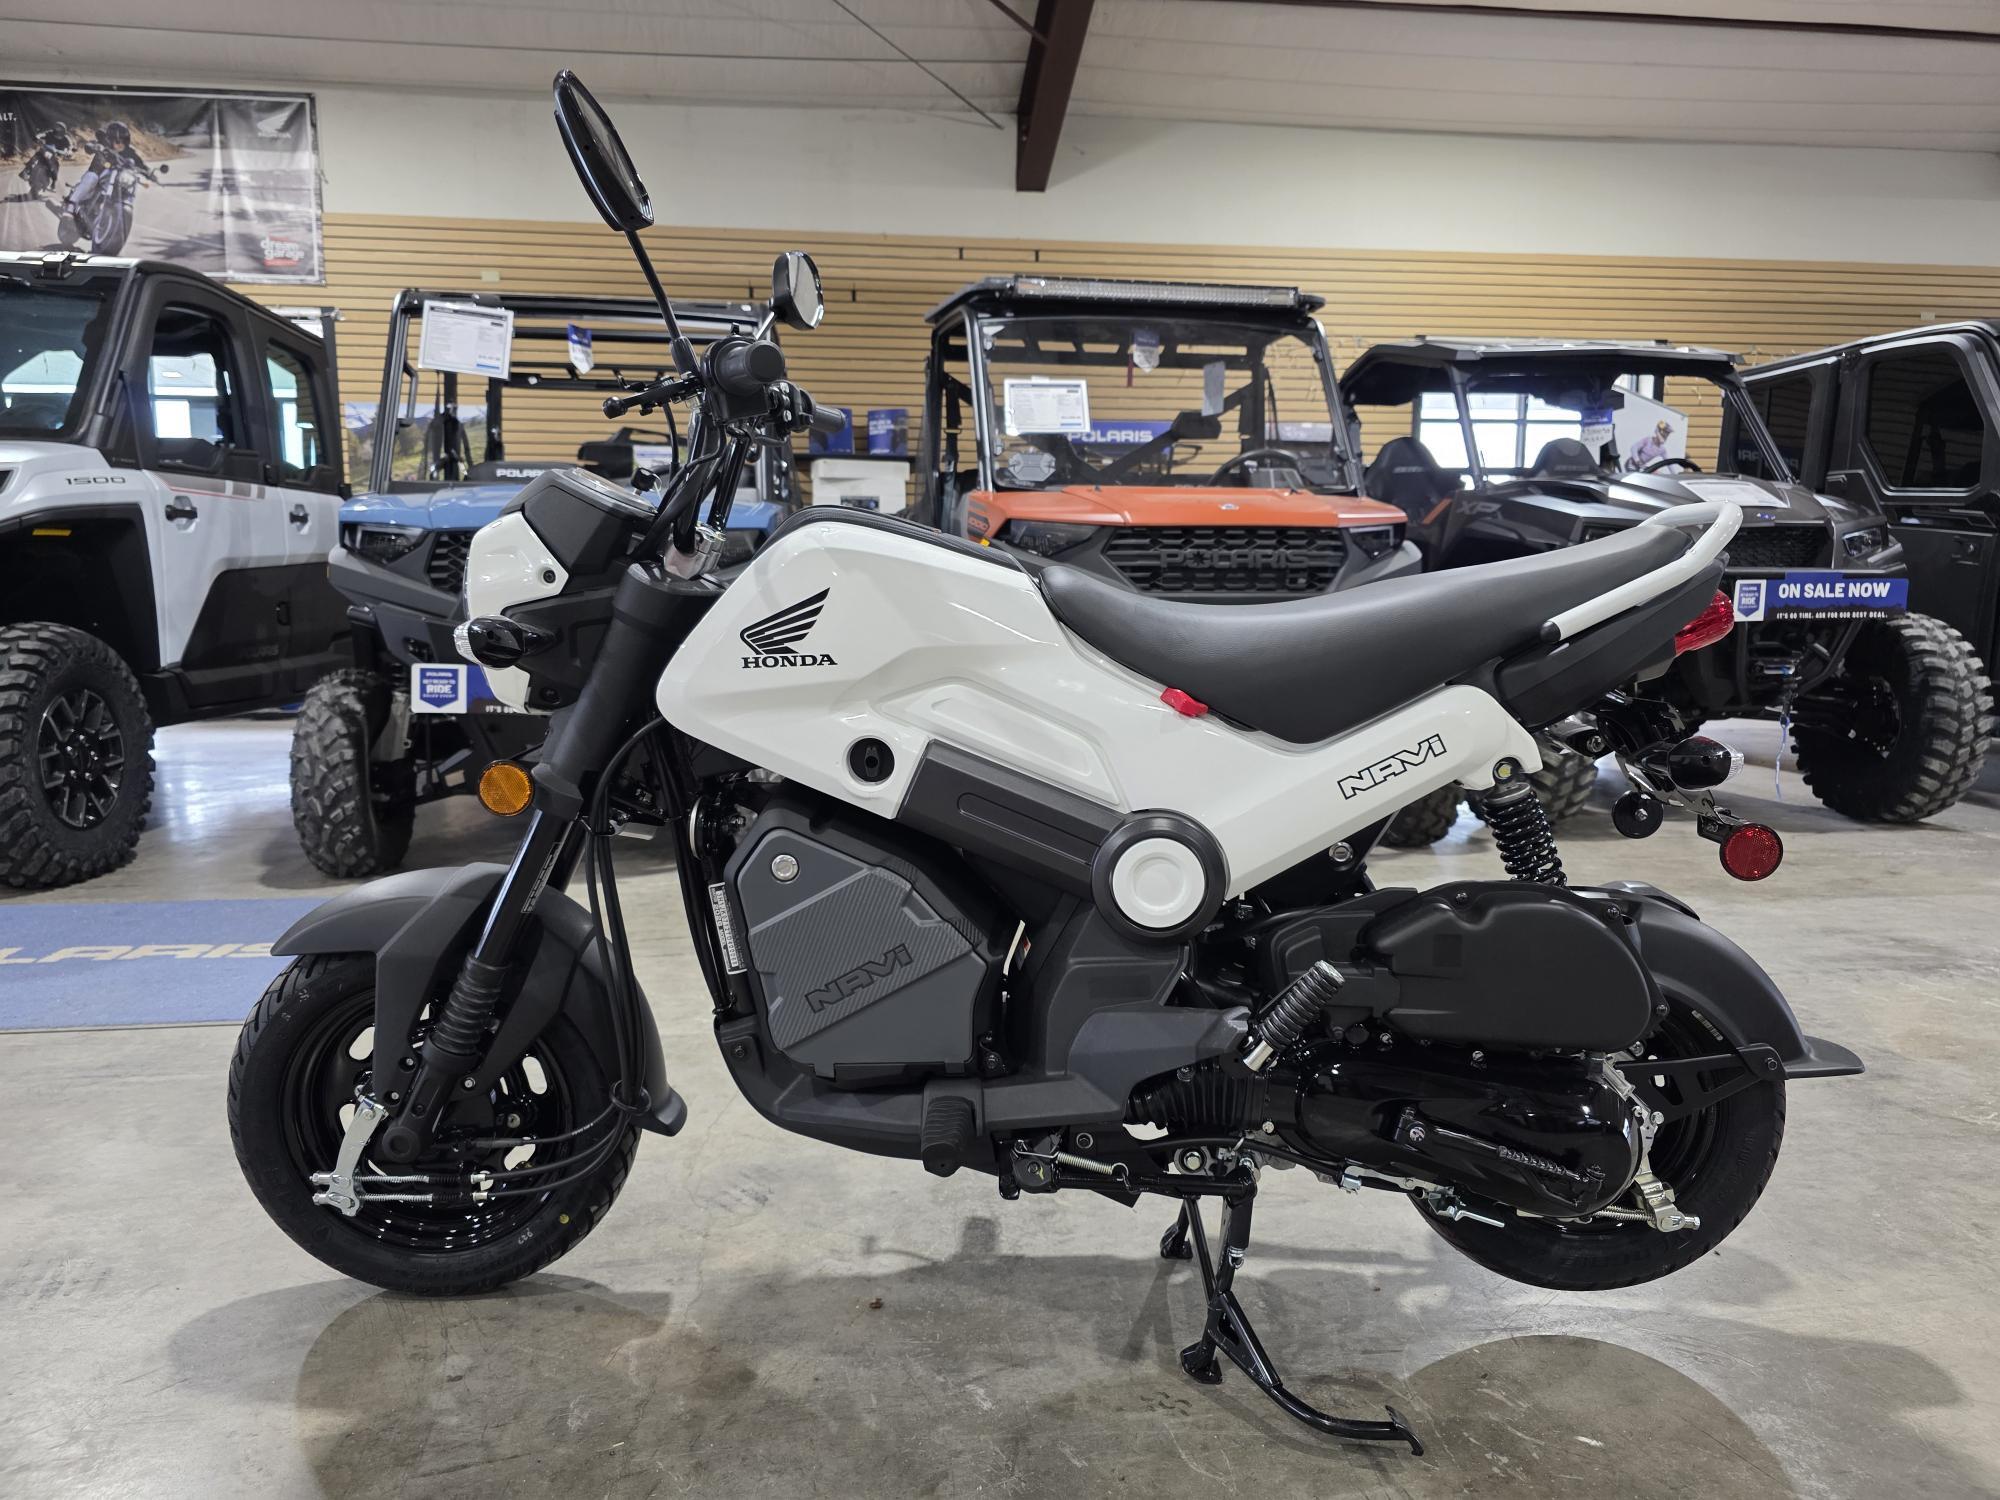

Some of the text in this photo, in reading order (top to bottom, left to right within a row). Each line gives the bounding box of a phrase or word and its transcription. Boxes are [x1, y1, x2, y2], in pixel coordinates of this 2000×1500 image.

[1067, 430, 1154, 443] POLARIS
[66, 476, 126, 485] 1500
[1160, 549, 1308, 569] POLARIS
[1778, 582, 1890, 599] ON SALE NOW
[741, 653, 838, 669] HONDA
[426, 684, 452, 694] RIDE
